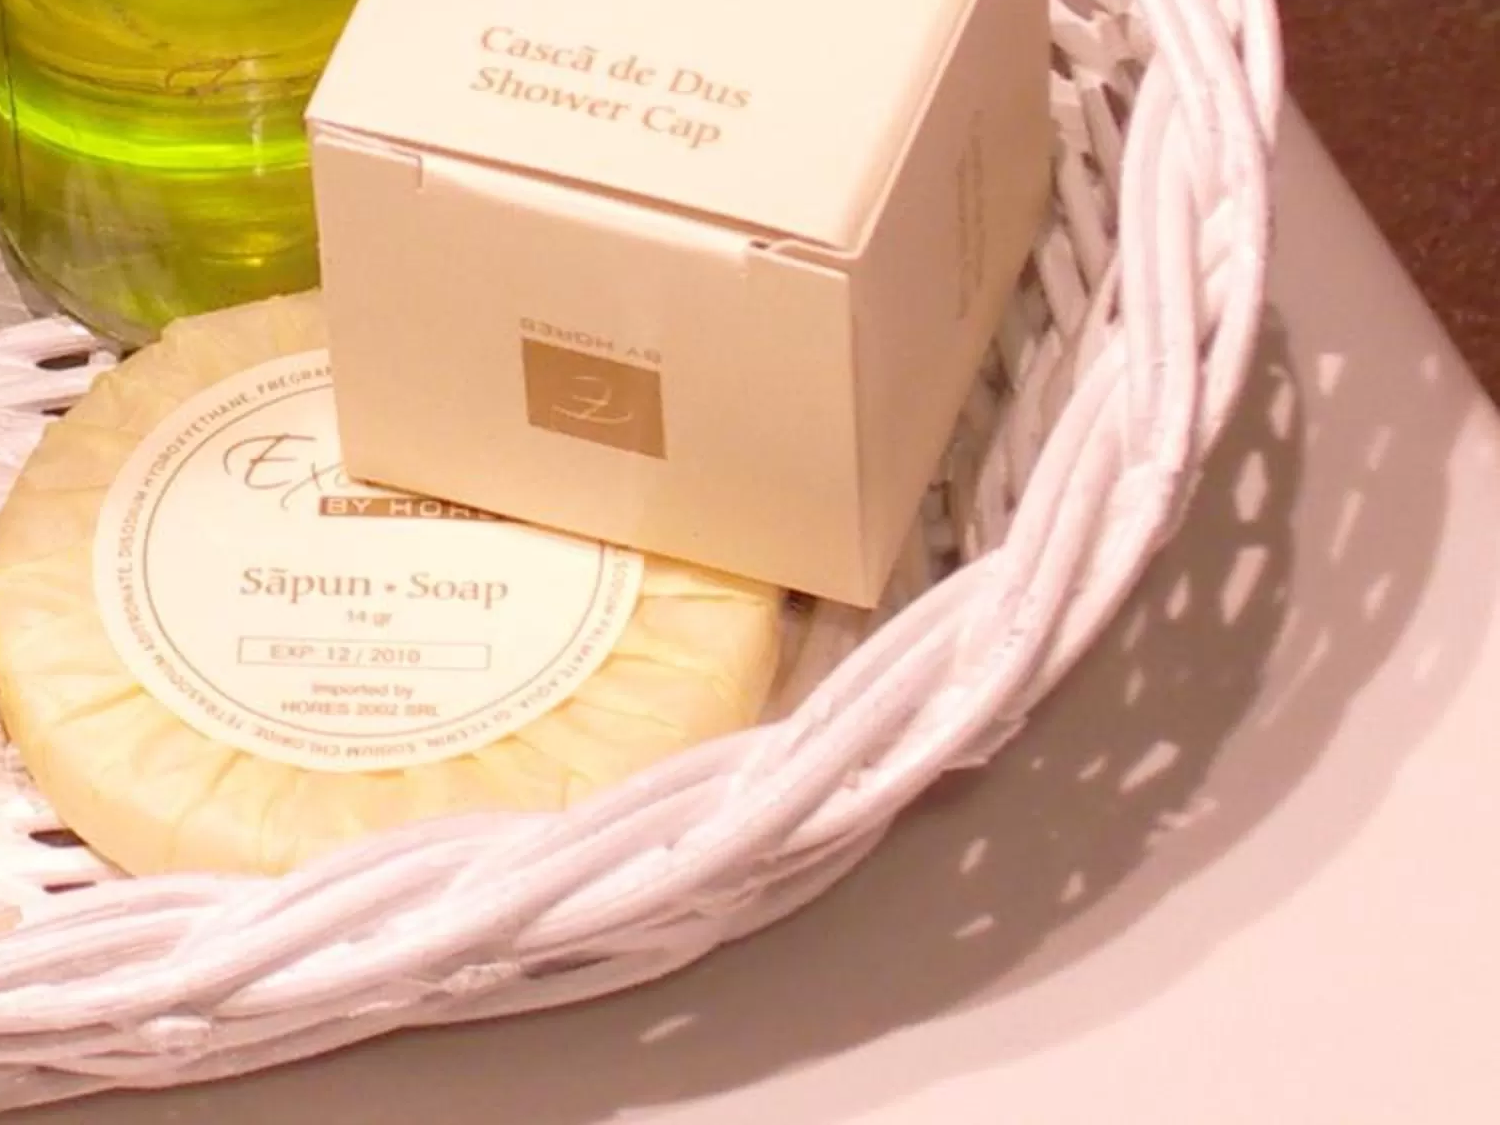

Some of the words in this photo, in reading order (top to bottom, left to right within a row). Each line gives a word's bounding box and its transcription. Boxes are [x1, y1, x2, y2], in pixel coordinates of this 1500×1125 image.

[607, 54, 658, 86] de
[667, 68, 753, 108] Dus
[469, 65, 632, 122] Shower
[640, 104, 724, 150] Cap
[326, 497, 373, 516] BY
[406, 571, 509, 611] Soap
[346, 608, 369, 625] 14
[372, 611, 394, 628] gr
[326, 645, 352, 663] 12
[369, 646, 423, 665] 2010
[393, 683, 415, 700] by
[280, 699, 351, 718] HORES
[355, 701, 400, 717] 2002
